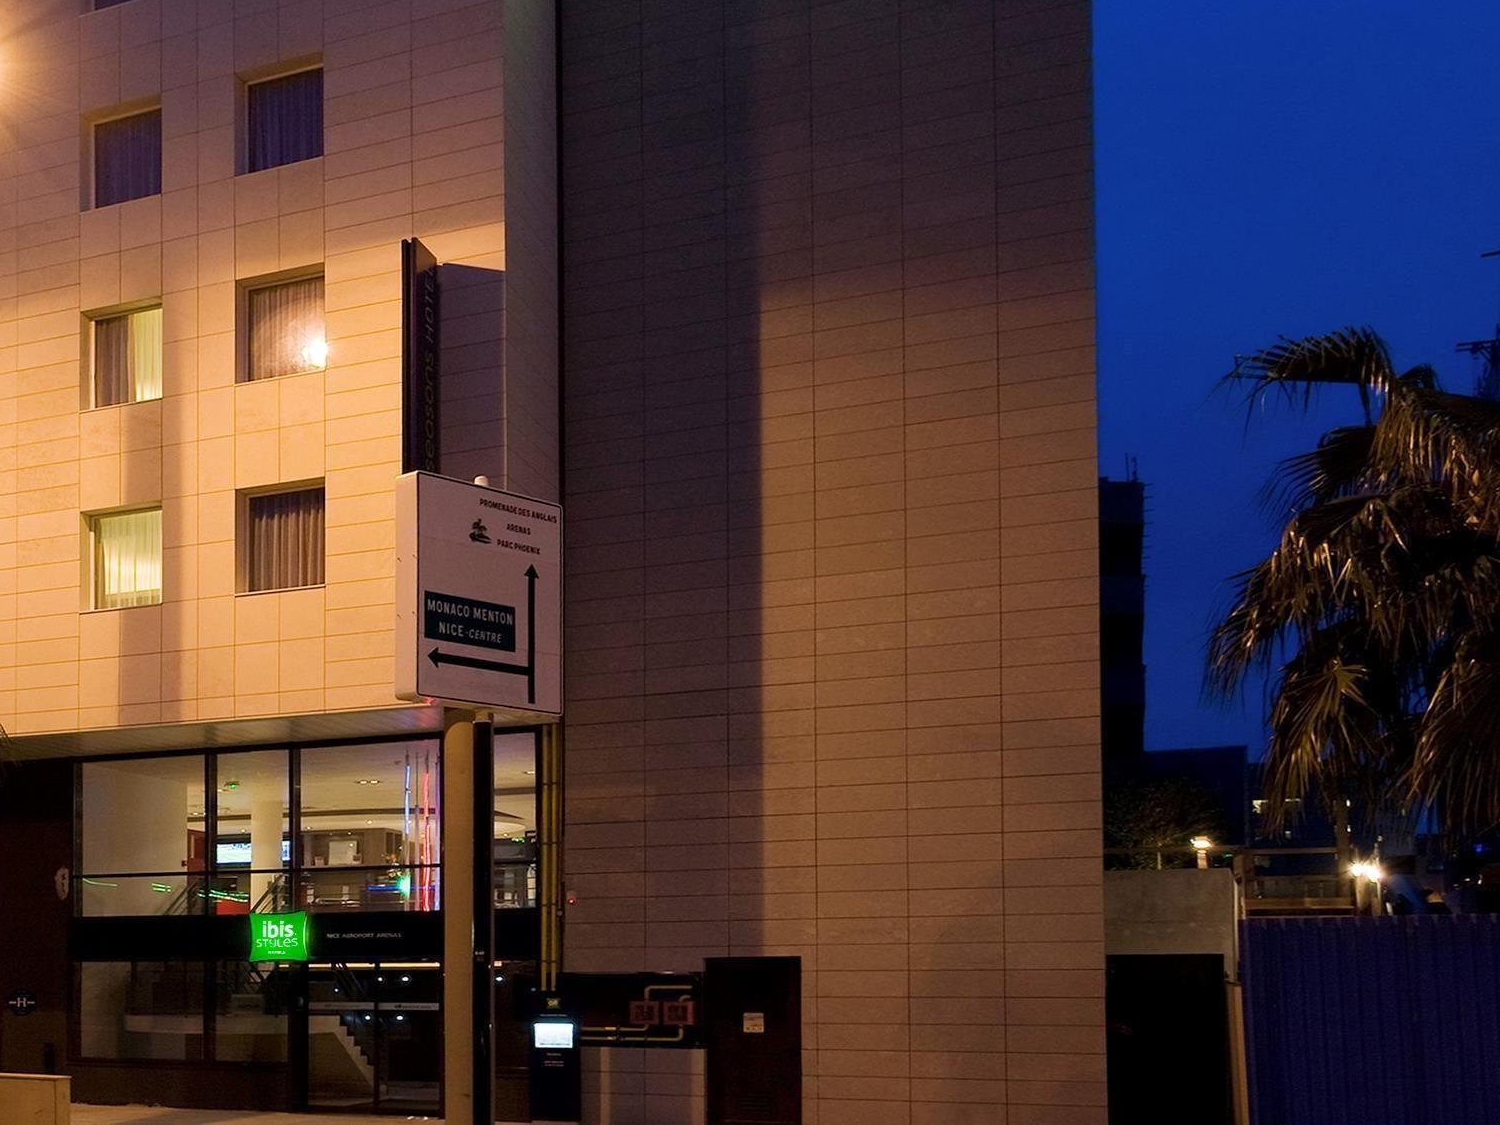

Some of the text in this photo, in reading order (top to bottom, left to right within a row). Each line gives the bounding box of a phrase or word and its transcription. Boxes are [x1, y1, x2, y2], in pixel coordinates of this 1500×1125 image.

[479, 498, 557, 523] PROMENADE DES ANGLAIS
[506, 523, 531, 535] ARENAS
[497, 539, 540, 555] PARC PHOENIX
[427, 598, 513, 625] MONACO MENTON
[262, 920, 294, 938] ibis
